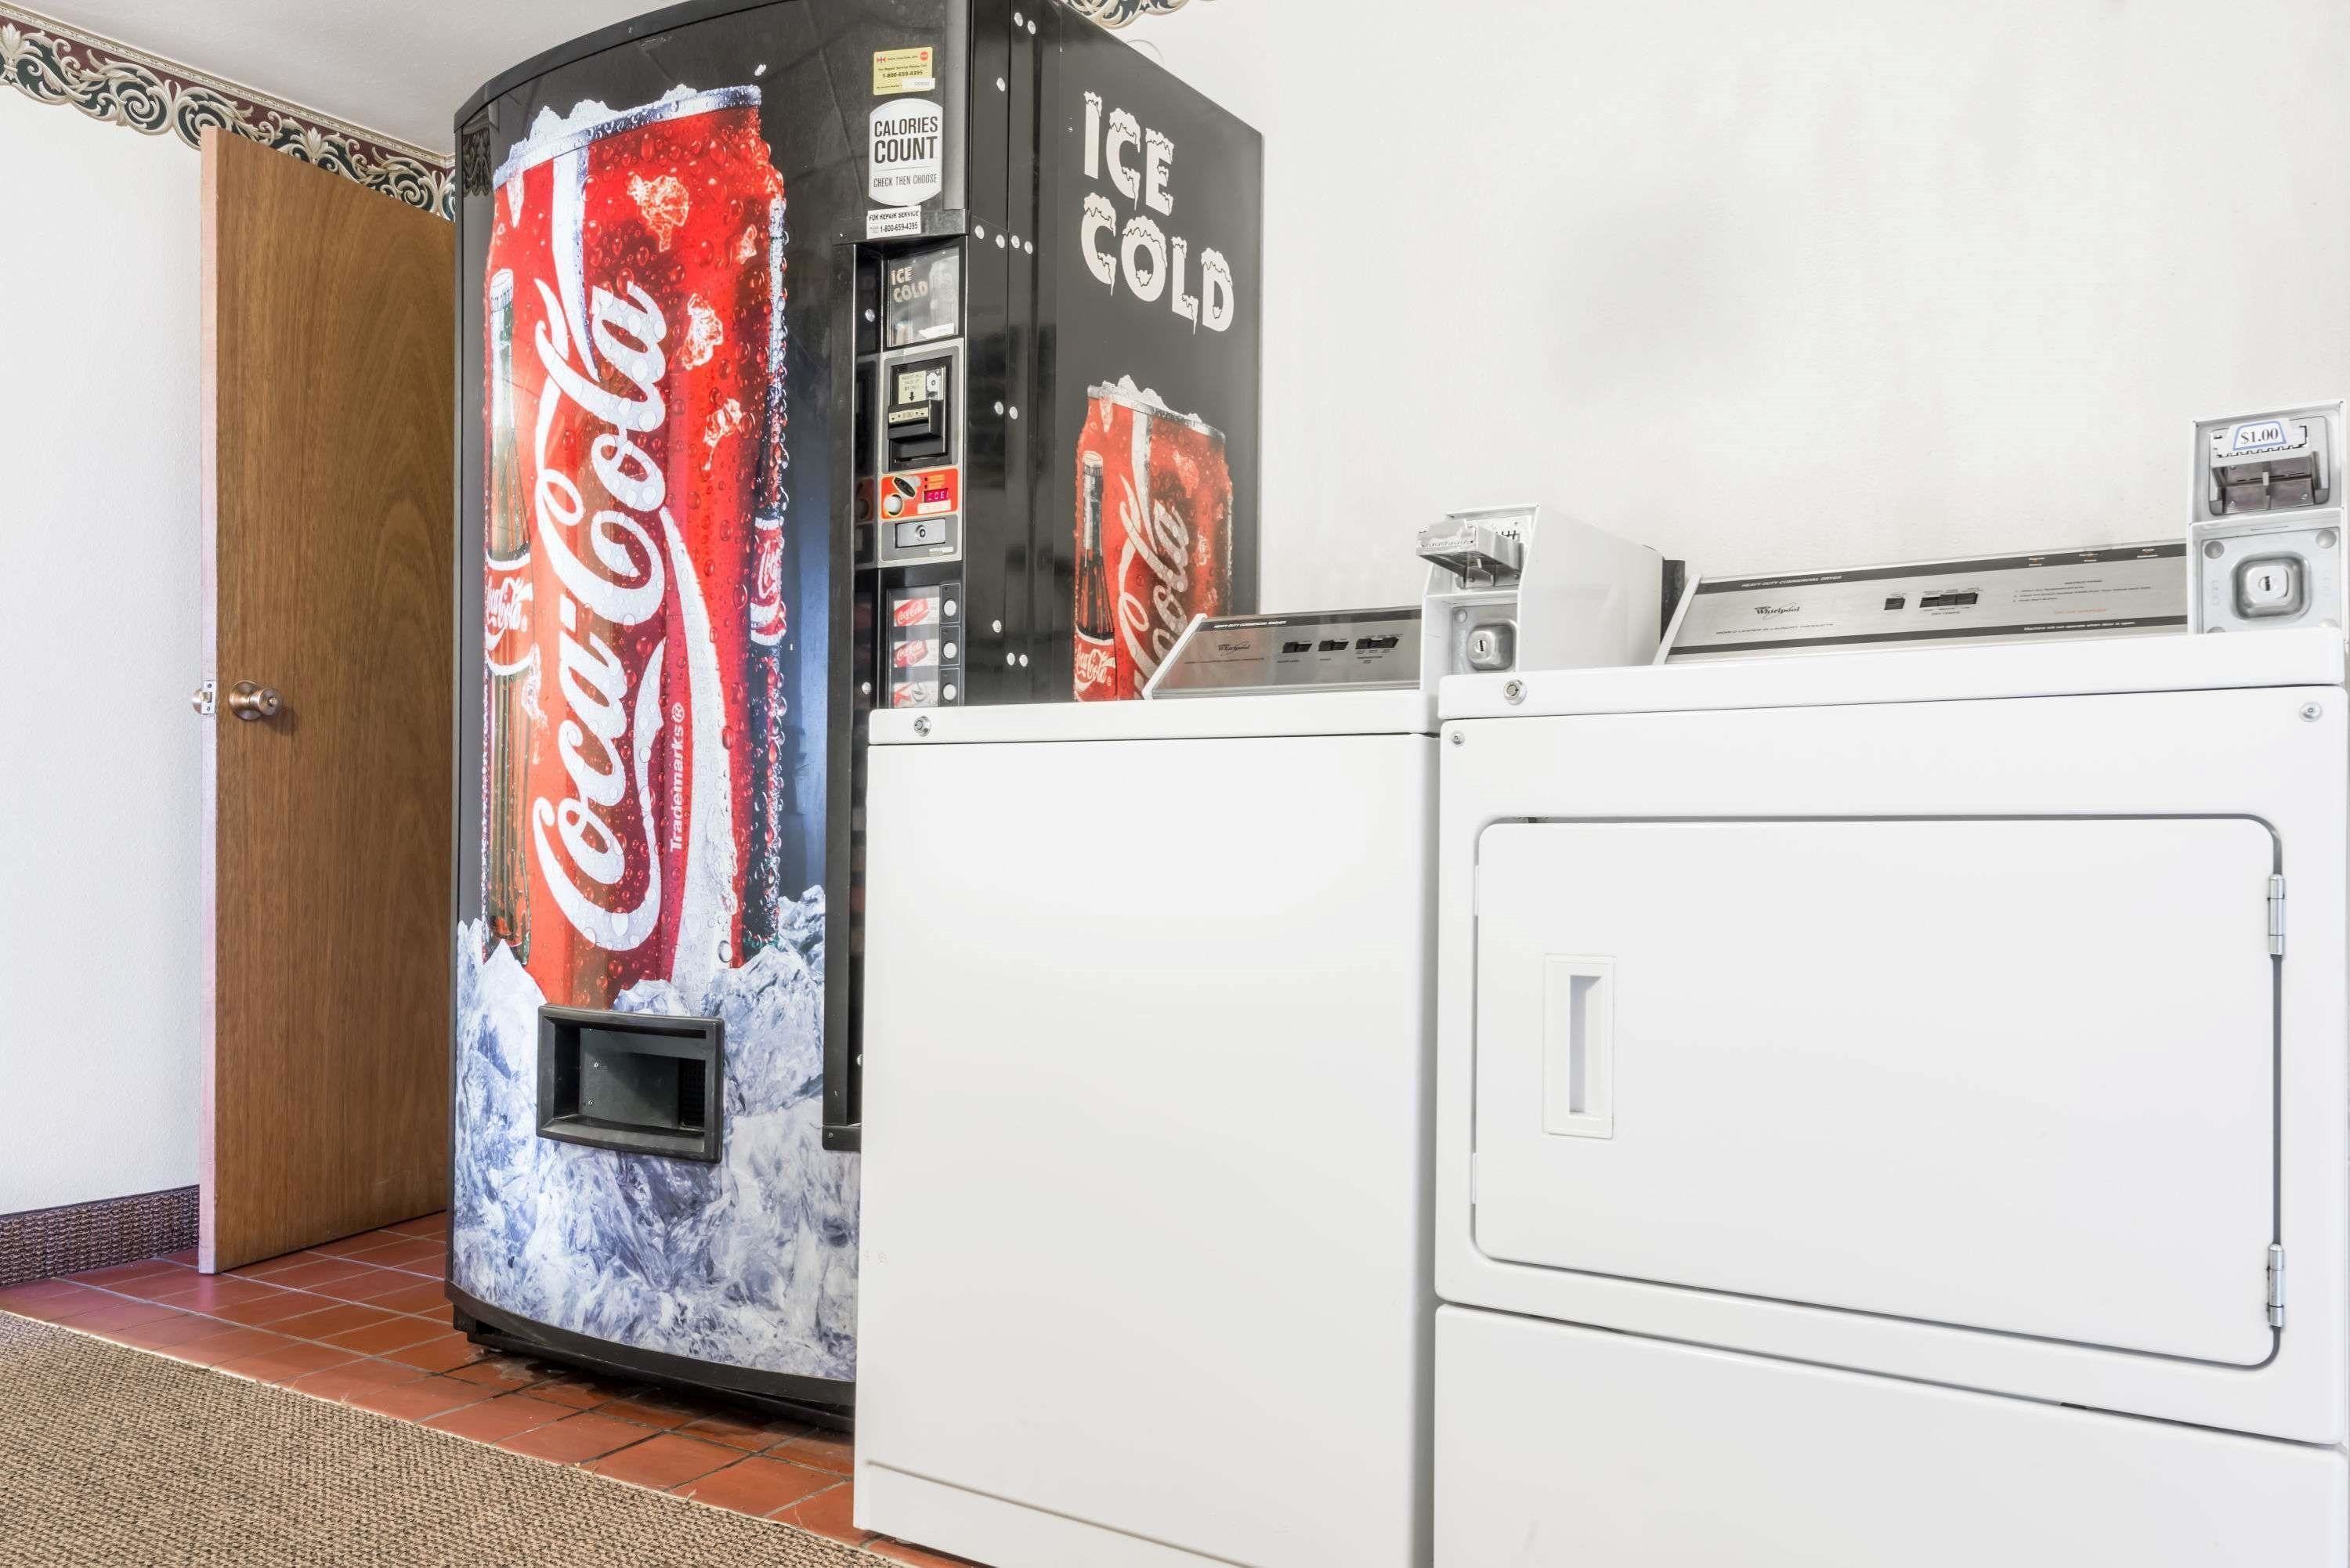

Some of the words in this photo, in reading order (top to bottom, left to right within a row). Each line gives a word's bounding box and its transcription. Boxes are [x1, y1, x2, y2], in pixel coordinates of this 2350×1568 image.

[874, 116, 938, 138] CALORIES
[874, 136, 938, 164] COUNT
[1084, 91, 1174, 217] ICE
[873, 174, 893, 188] CHECK
[895, 173, 911, 186] THEN
[913, 173, 937, 185] CHOOSE
[880, 222, 917, 233] 1-800-659-4395
[1081, 192, 1235, 335] COLD
[891, 266, 914, 285] ICE
[893, 280, 928, 303] COLD
[2240, 427, 2279, 444] $1.00
[533, 278, 667, 951] Coca-Cola
[1755, 605, 1800, 616] Whirlpool
